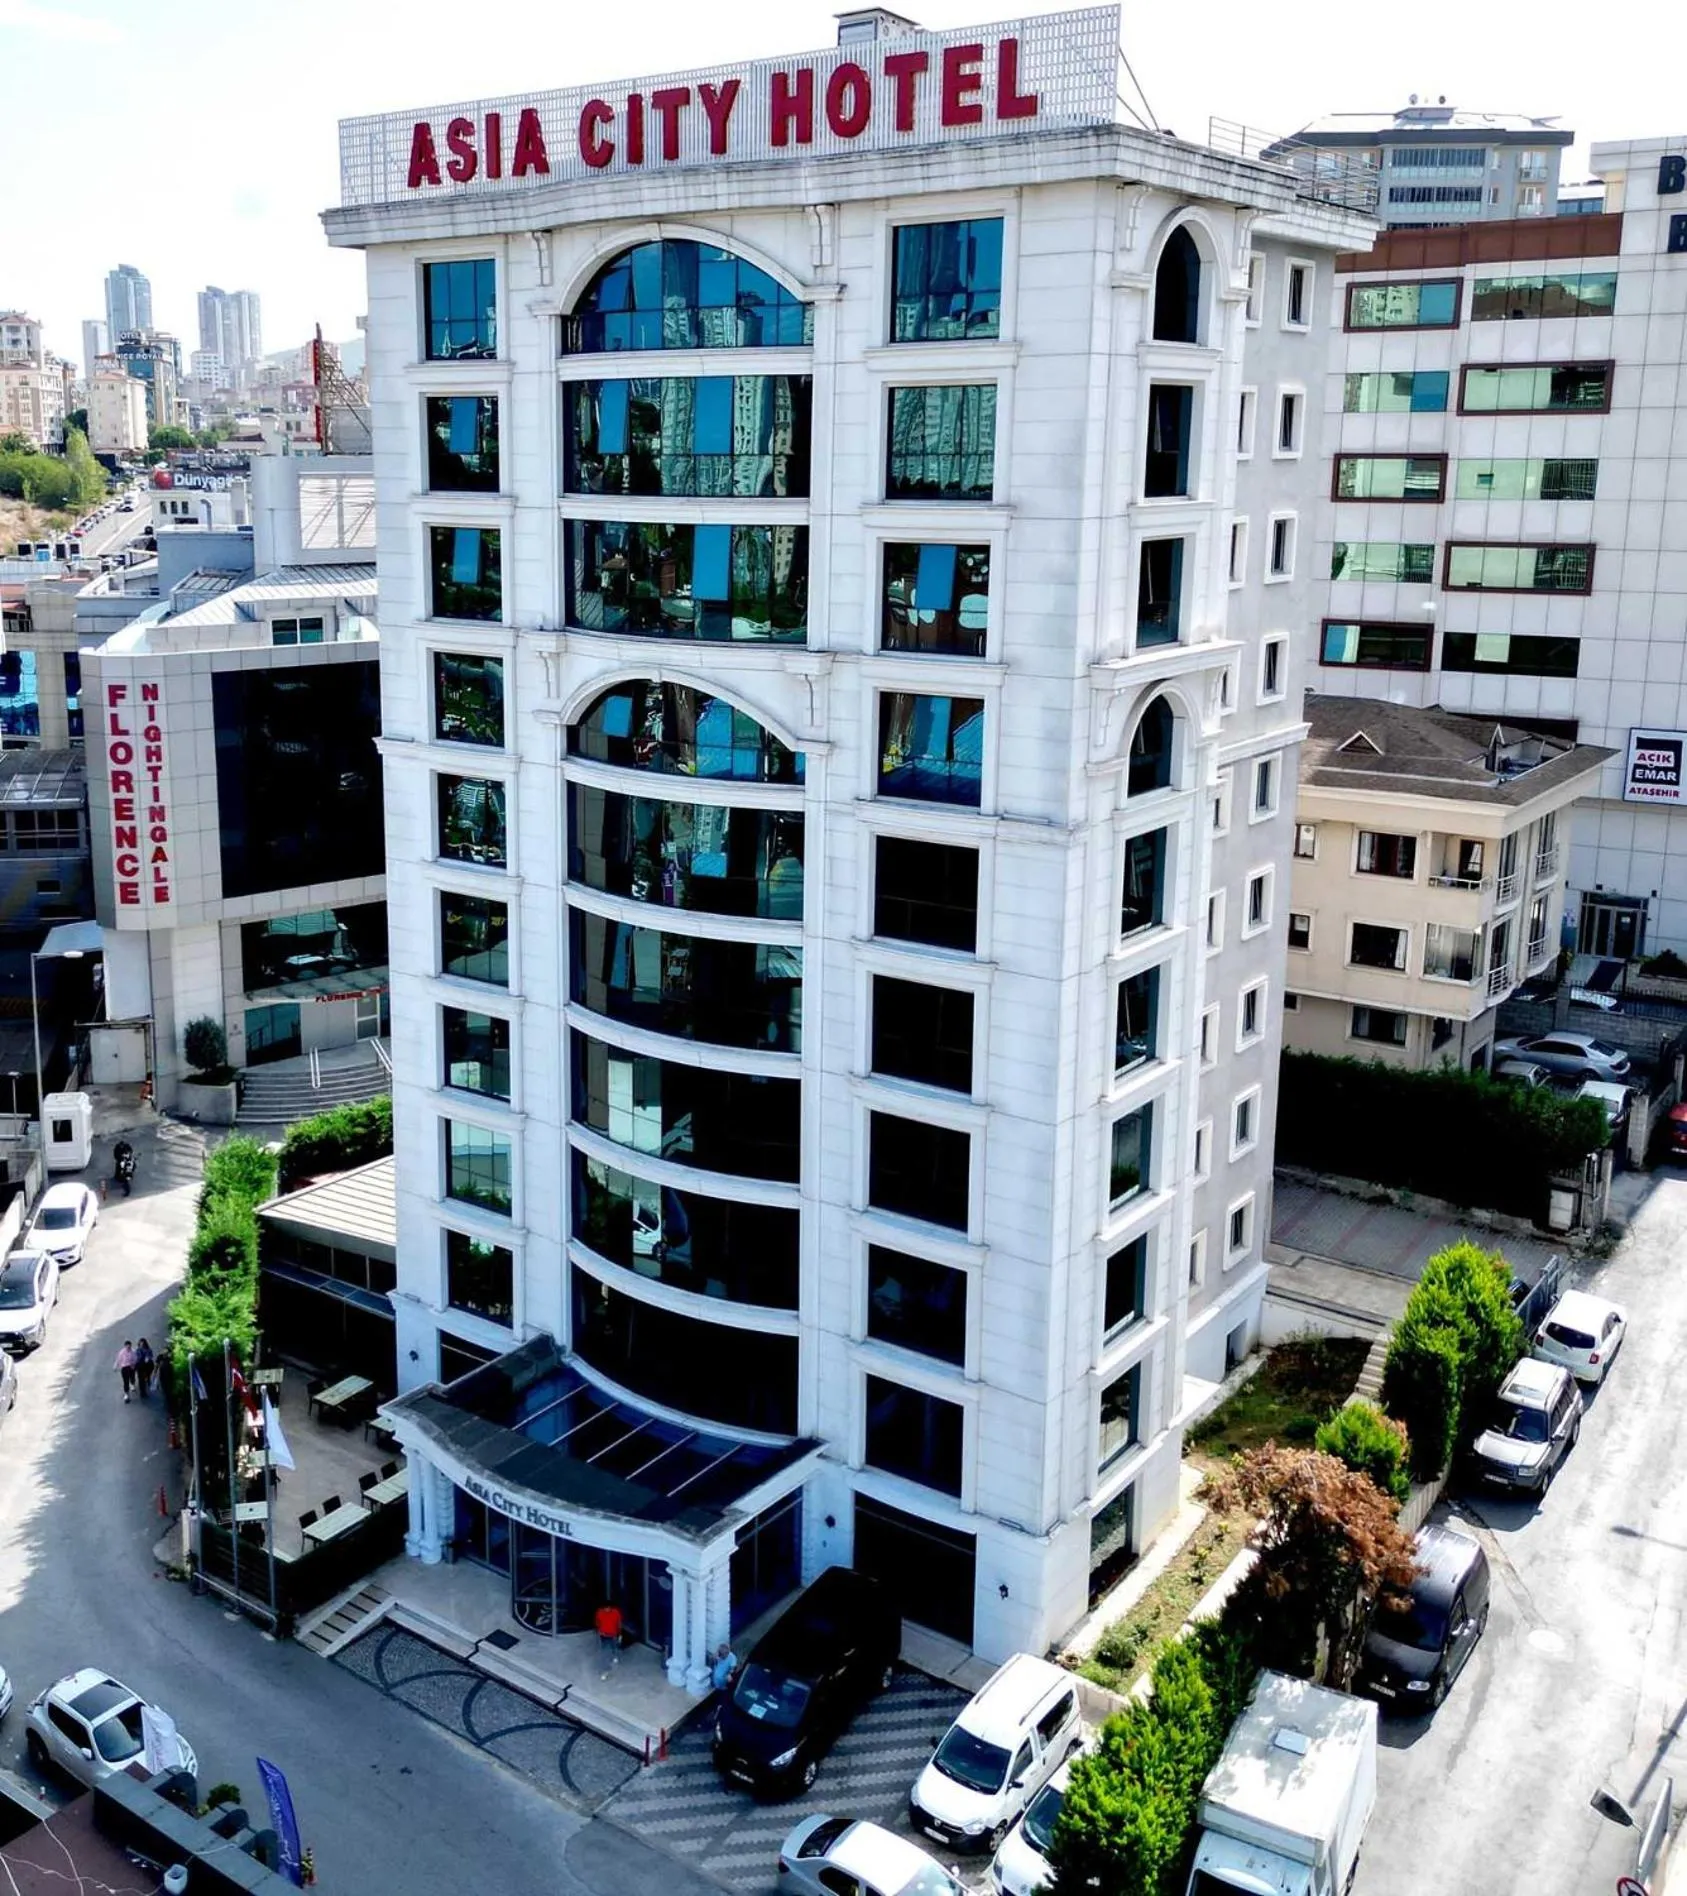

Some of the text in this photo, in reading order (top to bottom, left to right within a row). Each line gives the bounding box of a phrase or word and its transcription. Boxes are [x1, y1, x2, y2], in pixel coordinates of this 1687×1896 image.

[407, 37, 1039, 188] ASIA CITY HOTEL
[108, 685, 140, 905] FLORENCE
[142, 684, 170, 903] NIGHTINGALE
[1635, 769, 1677, 781] EMAR
